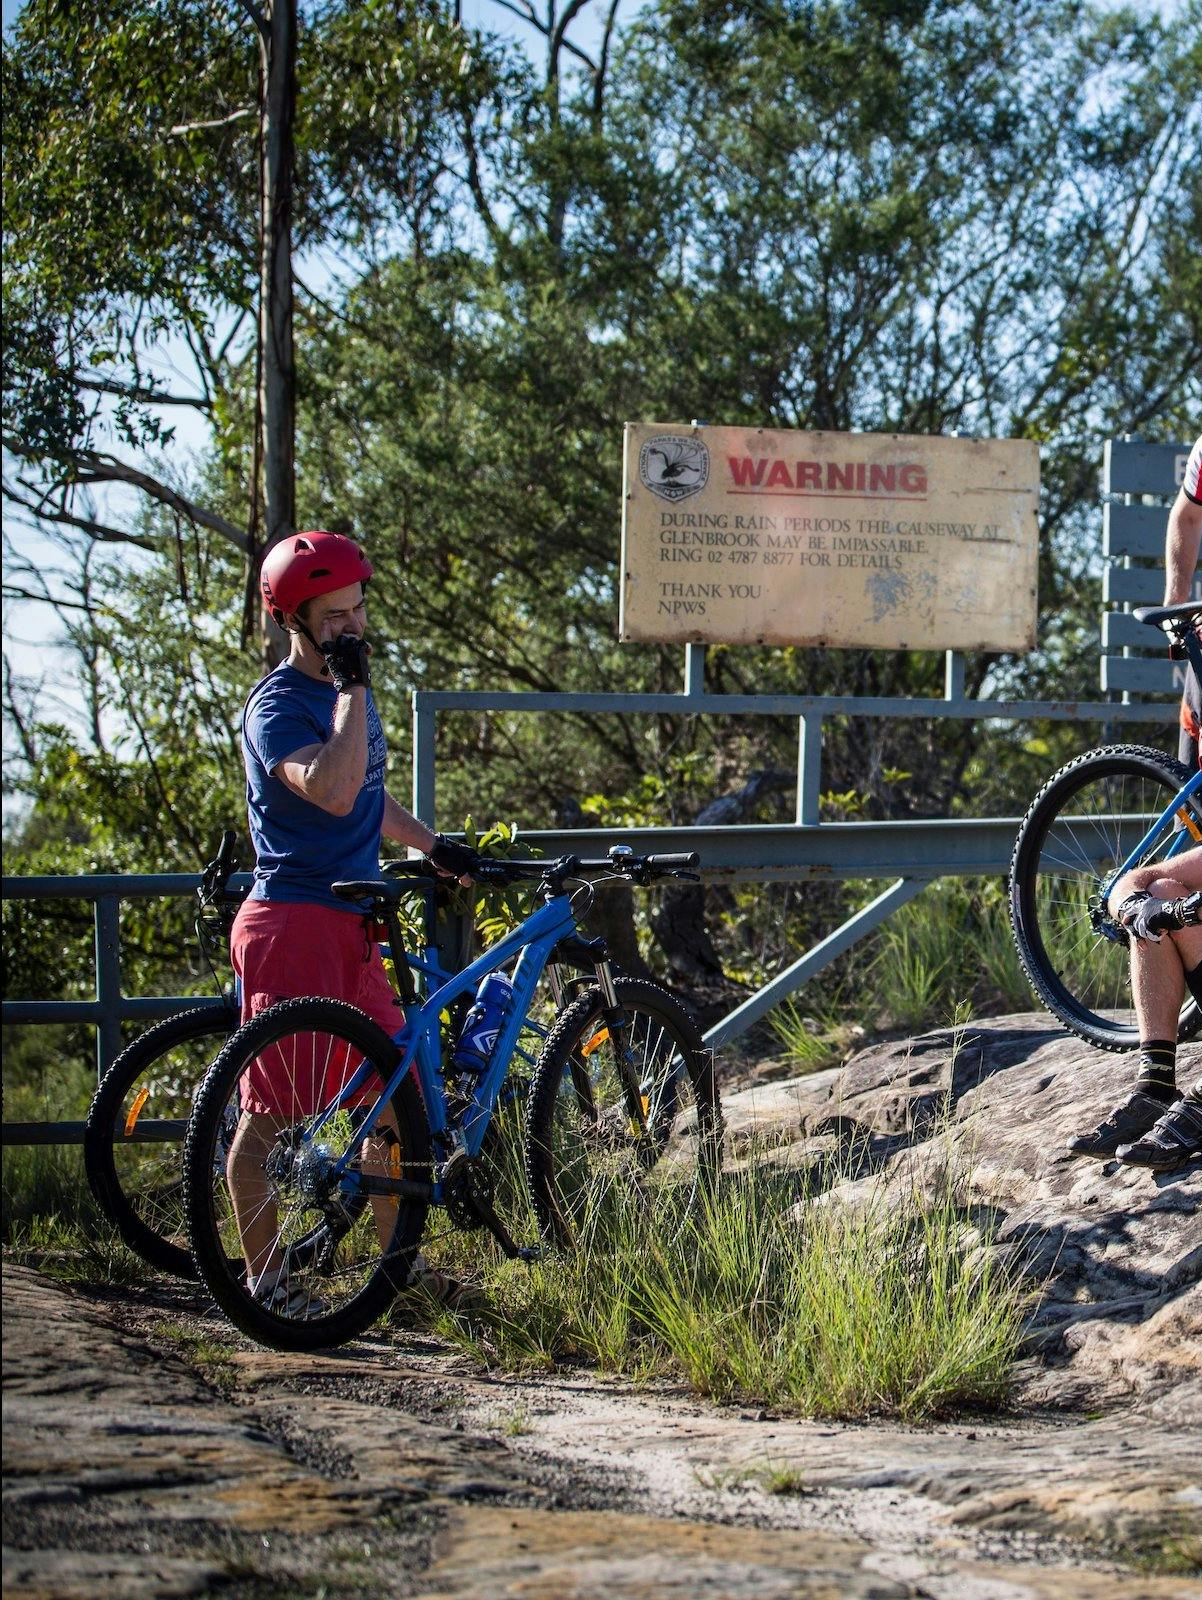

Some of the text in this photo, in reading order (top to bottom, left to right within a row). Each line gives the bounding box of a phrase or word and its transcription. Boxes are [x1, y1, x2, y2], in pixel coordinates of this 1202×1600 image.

[728, 457, 928, 494] WARNING
[660, 513, 1000, 539] DURING RAIN PERIODS THE CAUSEWAY AT
[660, 530, 929, 554] GLENBROOK MAY BE IMPASSABLE.
[659, 548, 903, 569] RING 02 4787 8877 FOR DETAILS
[659, 582, 762, 599] THANK YOU
[657, 600, 706, 616] NPWS
